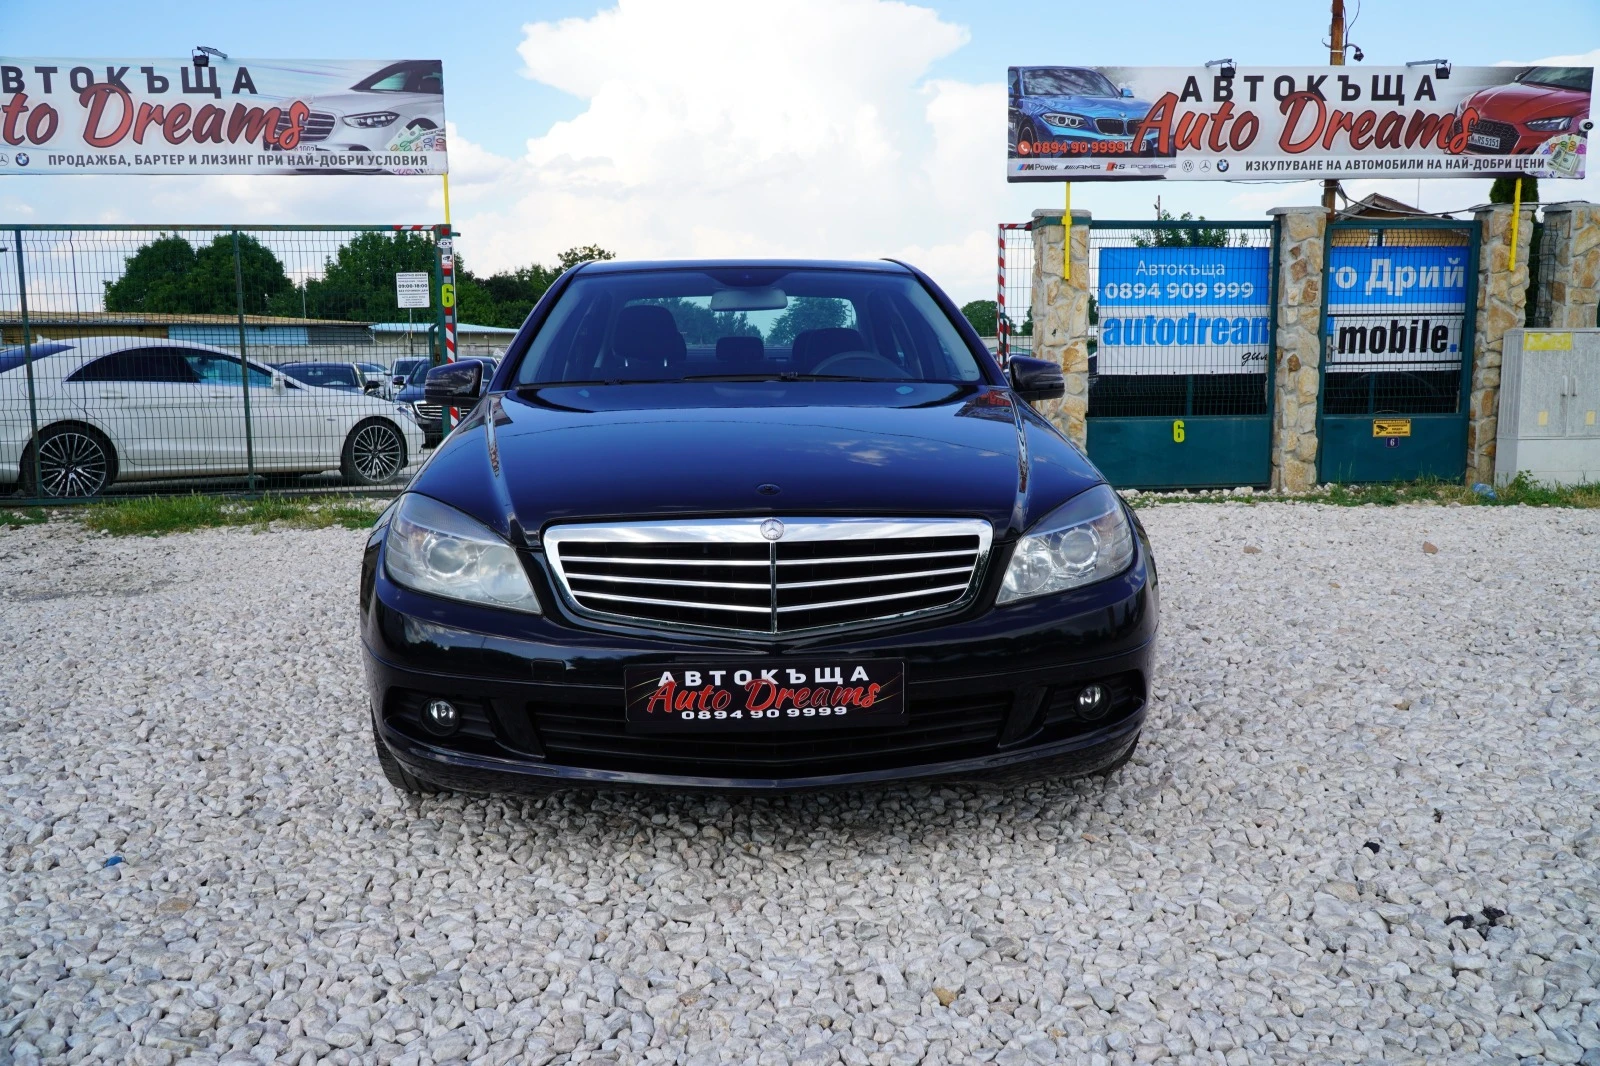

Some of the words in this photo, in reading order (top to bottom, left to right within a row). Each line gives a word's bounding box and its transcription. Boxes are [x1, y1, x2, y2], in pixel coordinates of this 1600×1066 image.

[0, 66, 258, 99] ВТОКЪЩА
[1179, 75, 1437, 106] АВТОКЪЩА
[79, 83, 310, 151] Dreams
[1131, 91, 1260, 155] Auto
[1279, 91, 1479, 155] Dreams
[1032, 141, 1068, 154] 0894
[1071, 141, 1089, 154] 90
[1091, 141, 1126, 154] 9999
[1484, 137, 1499, 148] 5151
[48, 154, 131, 167] ПРОДАЖБА,
[135, 154, 185, 166] БАРТЕР
[189, 154, 198, 165] И
[201, 154, 254, 166] ЛИЗИНГ
[257, 155, 284, 166] ПРИ
[287, 152, 364, 167] НАЙ-ДОБРИ
[367, 155, 428, 166] УСЛОВИЯ
[1245, 160, 1323, 171] ИЗКУПУВАНЕ
[1326, 160, 1342, 170] НА
[1345, 159, 1423, 170] АВТОМОБИЛИ
[1427, 159, 1442, 170] НА
[1445, 157, 1512, 171] НАЙ-ДОБРИ
[1515, 158, 1545, 170] ЦЕНИ
[1136, 260, 1225, 278] Автокъща
[441, 284, 454, 307] 6
[1105, 282, 1161, 299] 0894
[1167, 282, 1208, 299] 909
[1213, 281, 1254, 299] 999
[1338, 319, 1463, 354] mobile.
[1173, 420, 1185, 443] 6
[1390, 438, 1395, 447] 6
[657, 665, 869, 687] АВТОКЪЩА
[646, 680, 732, 714] Auto
[744, 678, 881, 712] Dreams
[681, 710, 743, 720] 0894
[751, 709, 780, 719] 90
[787, 706, 848, 718] 9999
